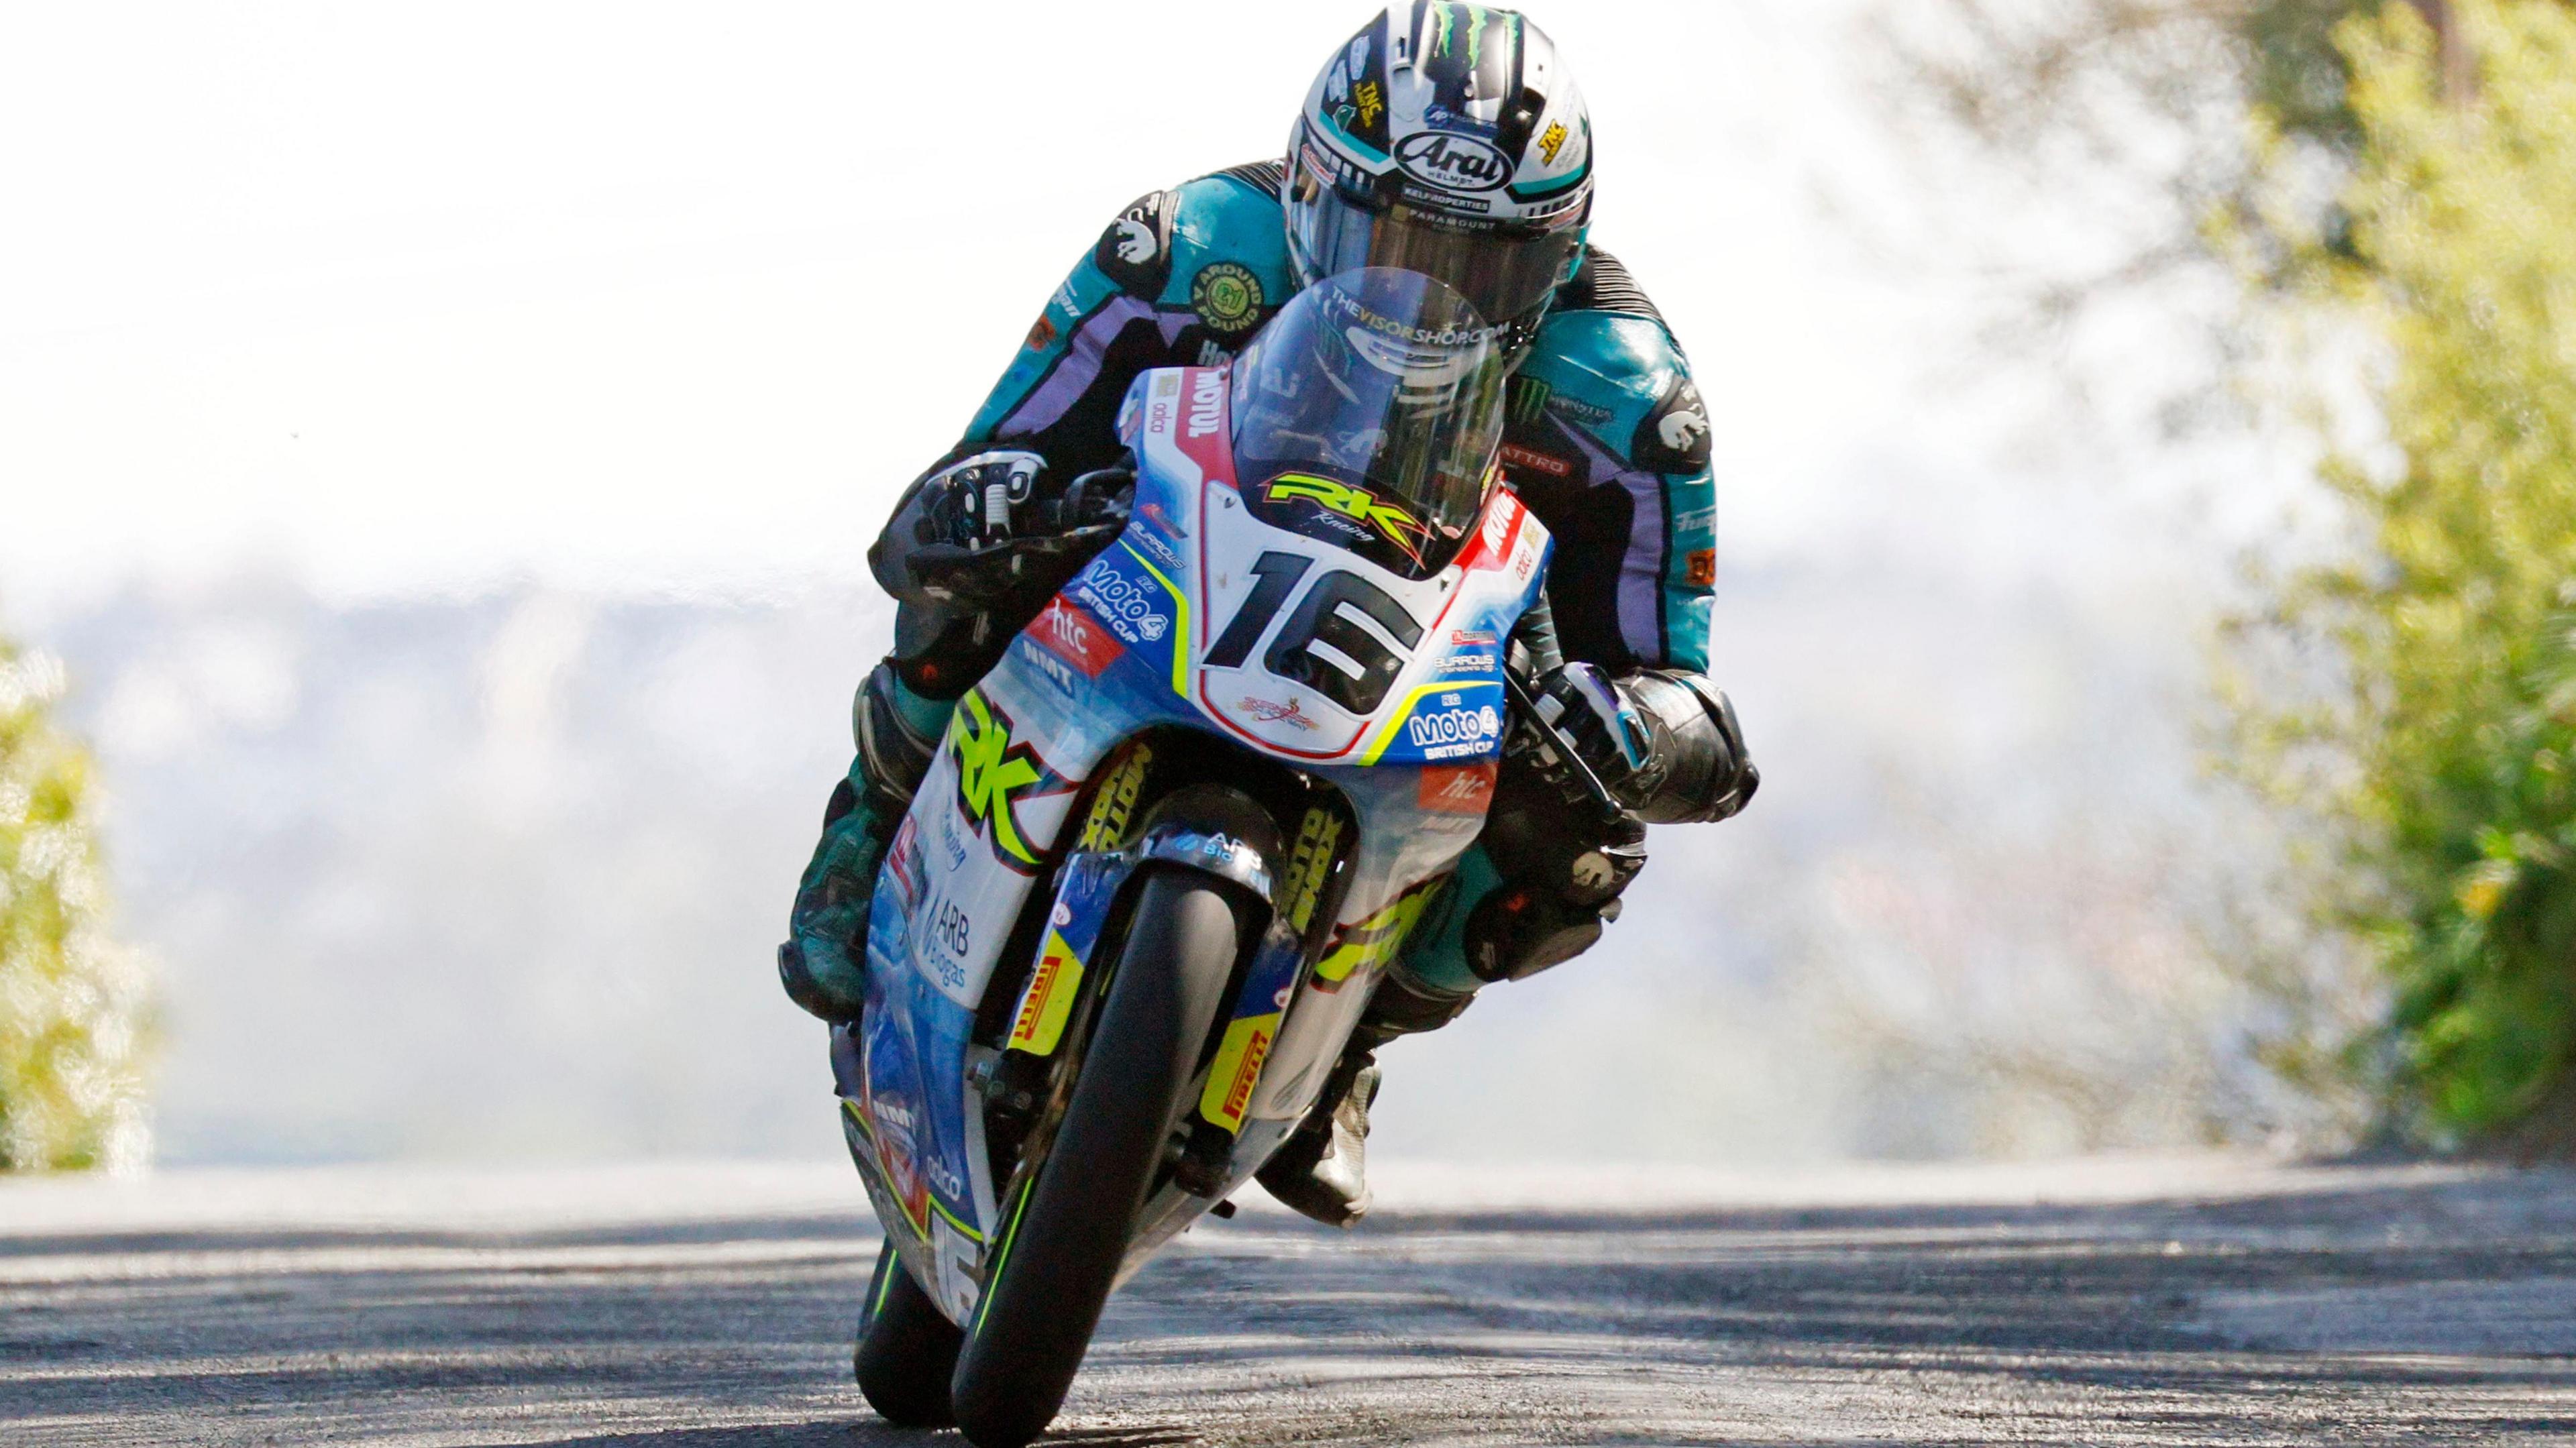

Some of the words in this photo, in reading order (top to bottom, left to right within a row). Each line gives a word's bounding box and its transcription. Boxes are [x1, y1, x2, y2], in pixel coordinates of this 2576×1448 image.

[1362, 81, 1383, 117] TNC
[1399, 135, 1501, 182] Arai
[1428, 171, 1474, 186] HELMET
[1409, 209, 1496, 230] PARAMOUNT
[1187, 368, 1228, 438] MOTUL
[1501, 445, 1564, 473] ATTRO
[1267, 473, 1419, 550] RK
[1311, 510, 1376, 541] Racing
[1077, 586, 1119, 624] BRITISH
[1111, 620, 1140, 645] CUP
[1083, 559, 1169, 642] Moto4
[1052, 598, 1088, 655] htc
[1202, 550, 1425, 716] 16
[1434, 655, 1495, 668] BURROWS
[1409, 705, 1499, 746] Moto4
[1424, 743, 1475, 761] BRITISH
[1474, 740, 1495, 754] CUP
[937, 897, 969, 957] ARB
[930, 946, 966, 988] ogas
[1014, 956, 1063, 1041] PIRELLI
[1222, 1029, 1269, 1121] PIRELLI
